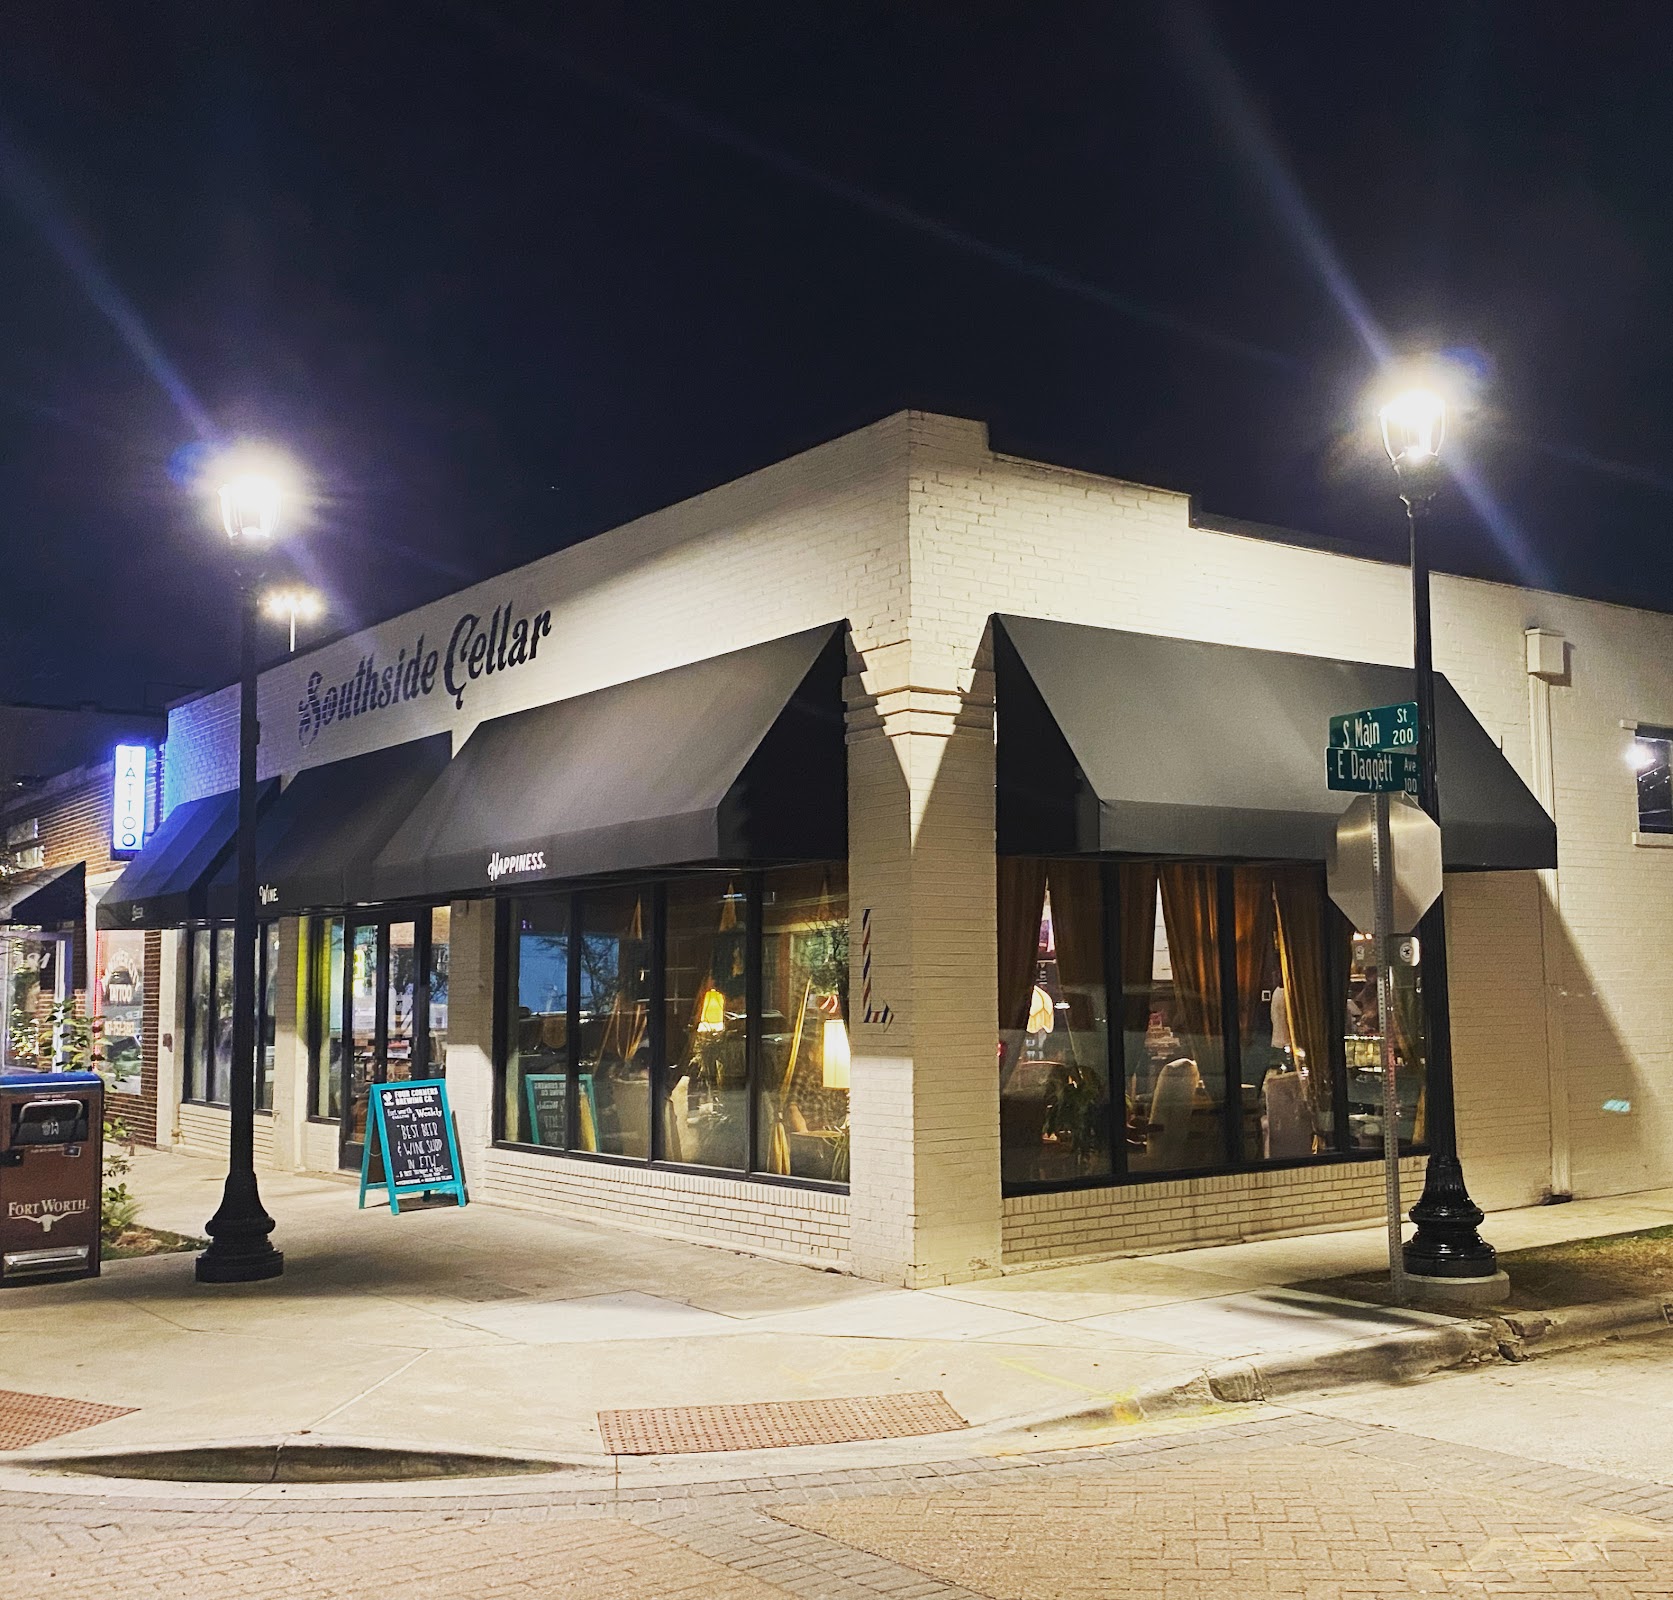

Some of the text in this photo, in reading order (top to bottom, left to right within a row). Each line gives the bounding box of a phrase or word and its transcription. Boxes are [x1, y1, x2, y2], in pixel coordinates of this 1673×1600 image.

[298, 601, 552, 748] Southside Cellar
[1343, 707, 1408, 749] S Main St
[1392, 728, 1414, 745] 200
[1337, 750, 1417, 790] E Daggett Ave
[1404, 777, 1418, 792] 100
[122, 750, 136, 847] TATTOO
